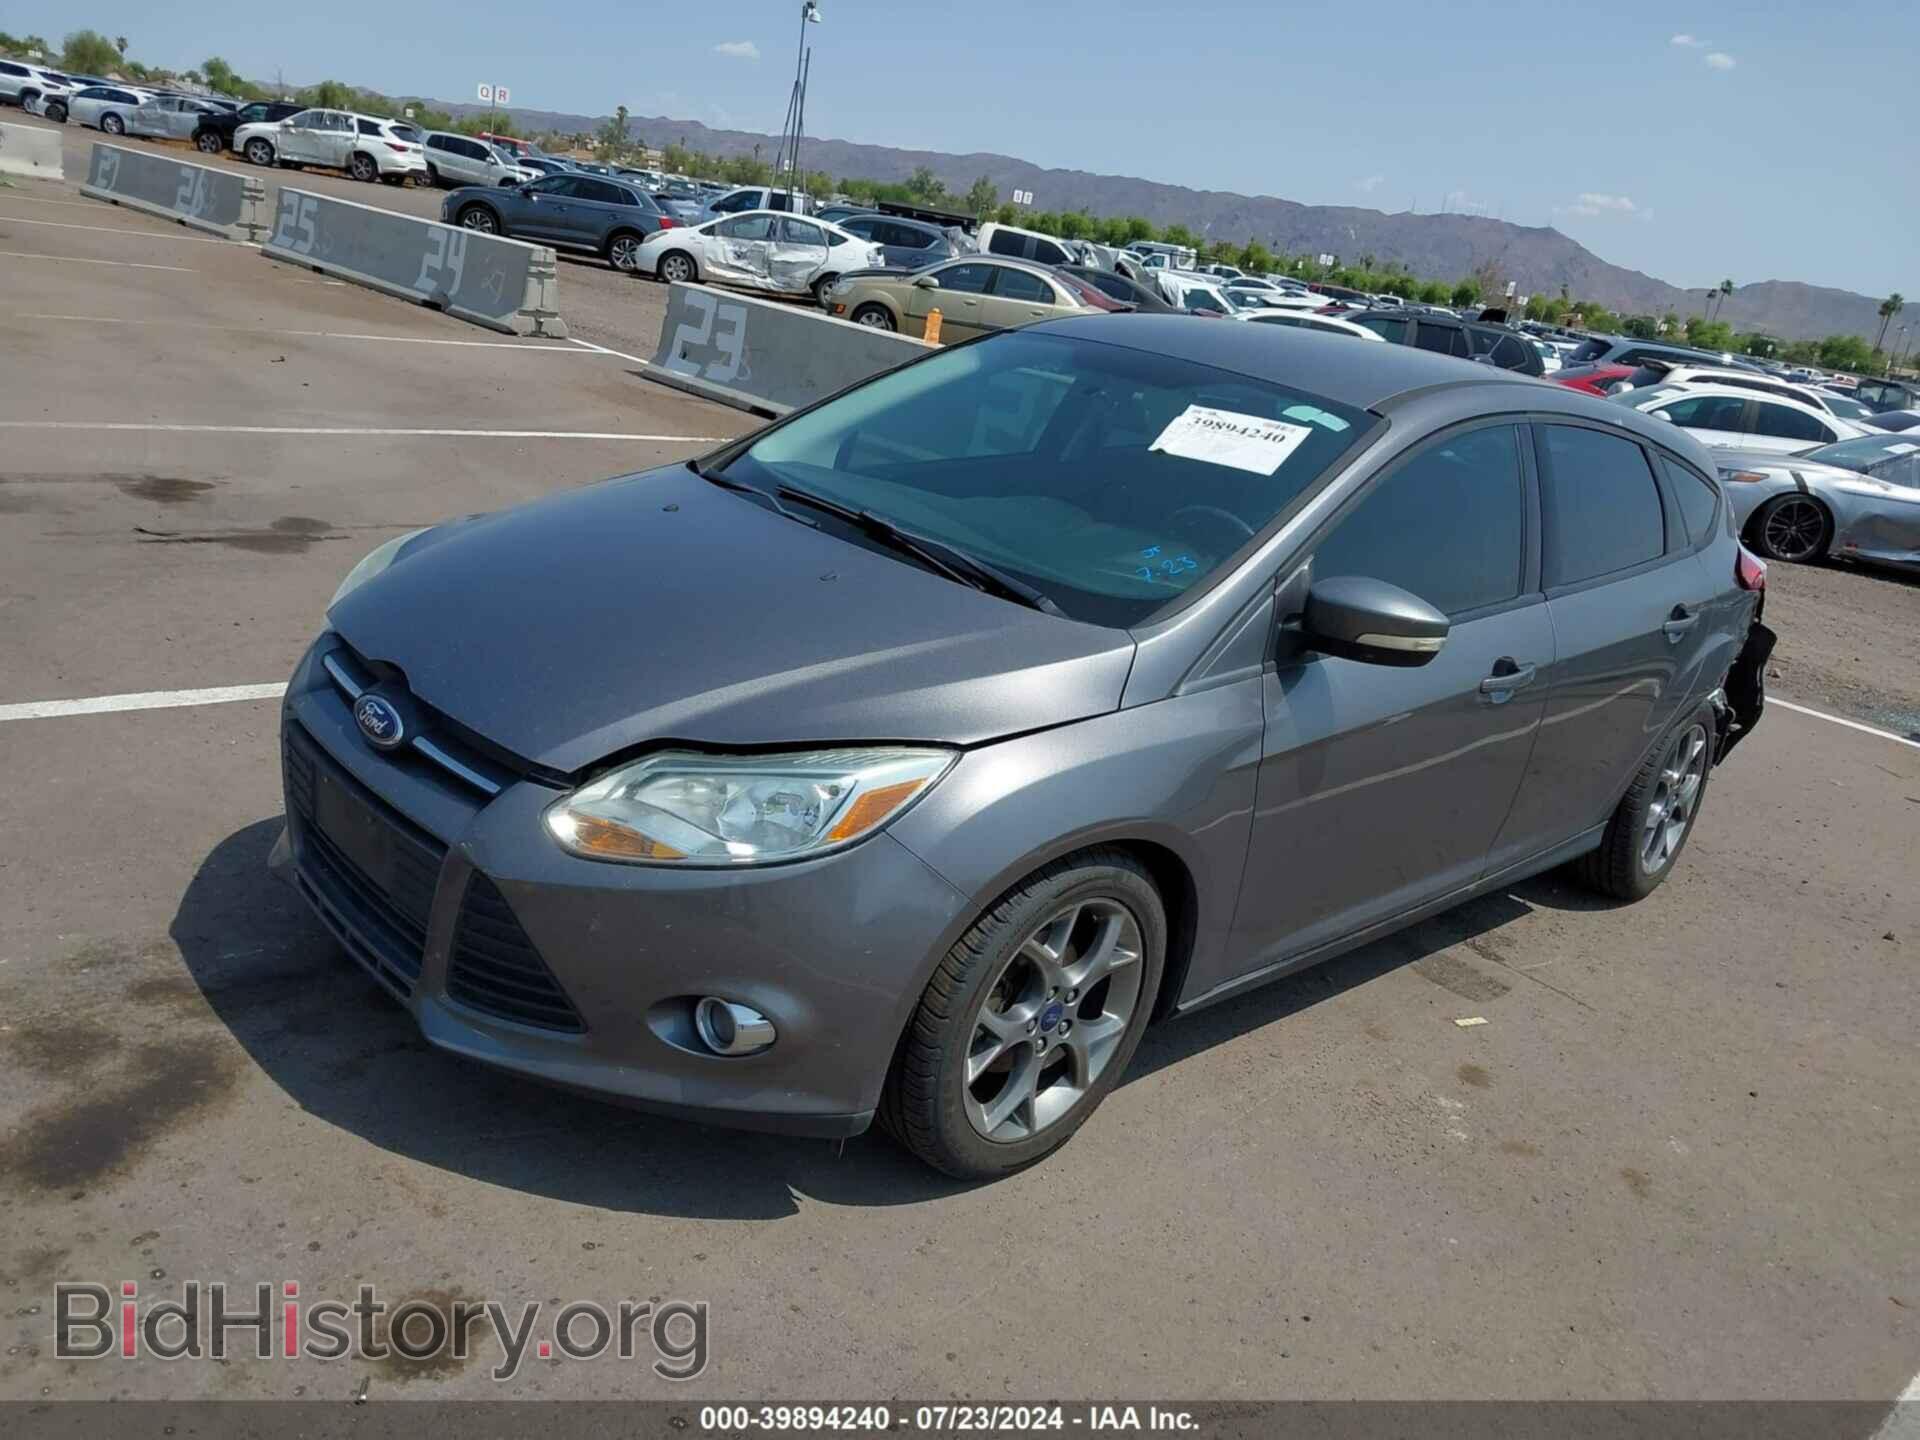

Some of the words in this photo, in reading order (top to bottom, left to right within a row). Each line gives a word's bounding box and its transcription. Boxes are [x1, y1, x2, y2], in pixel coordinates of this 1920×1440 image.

[480, 86, 491, 98] Q
[498, 88, 507, 101] R
[272, 191, 318, 255] 25
[413, 226, 468, 296] 24
[664, 290, 744, 382] 23
[359, 702, 389, 734] Ford
